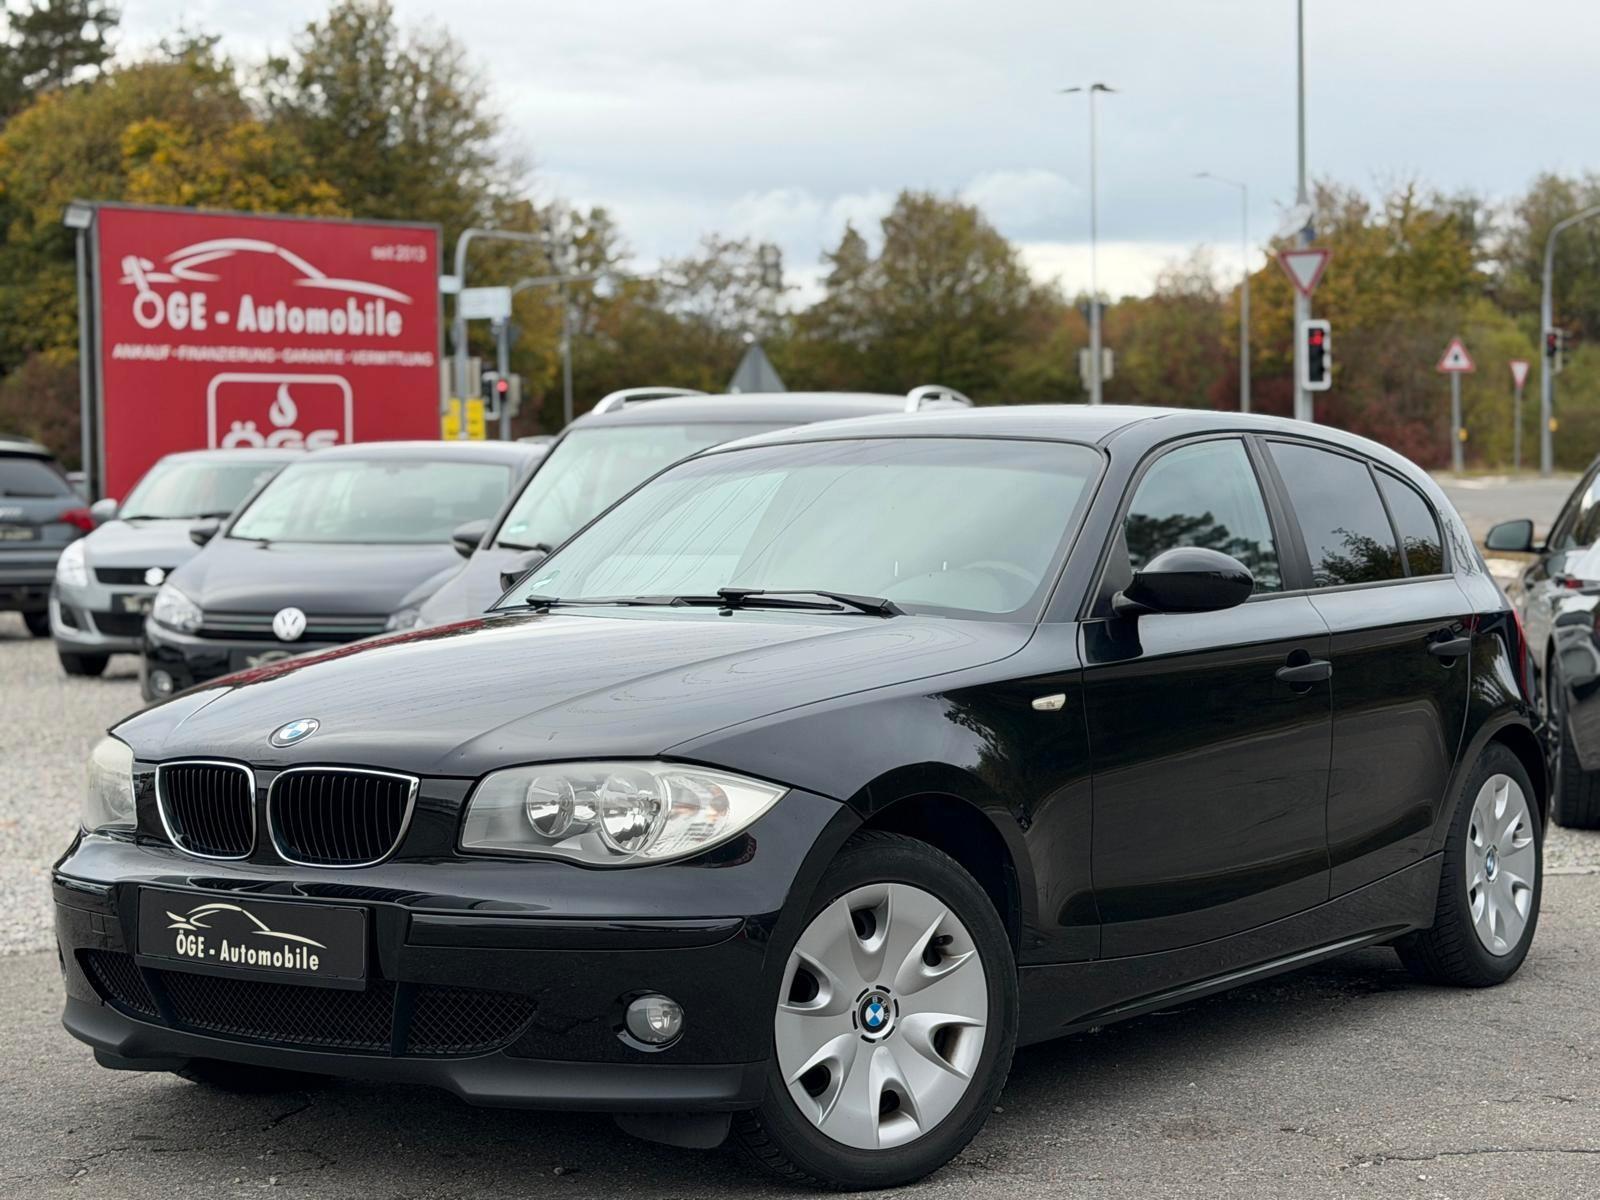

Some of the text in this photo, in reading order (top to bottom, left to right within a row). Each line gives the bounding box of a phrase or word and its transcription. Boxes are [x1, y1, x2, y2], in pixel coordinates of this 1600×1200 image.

[236, 294, 402, 338] Automobile
[112, 343, 171, 361] ANKAUF
[175, 930, 205, 958] ÖGE
[220, 939, 320, 971] Automobile
